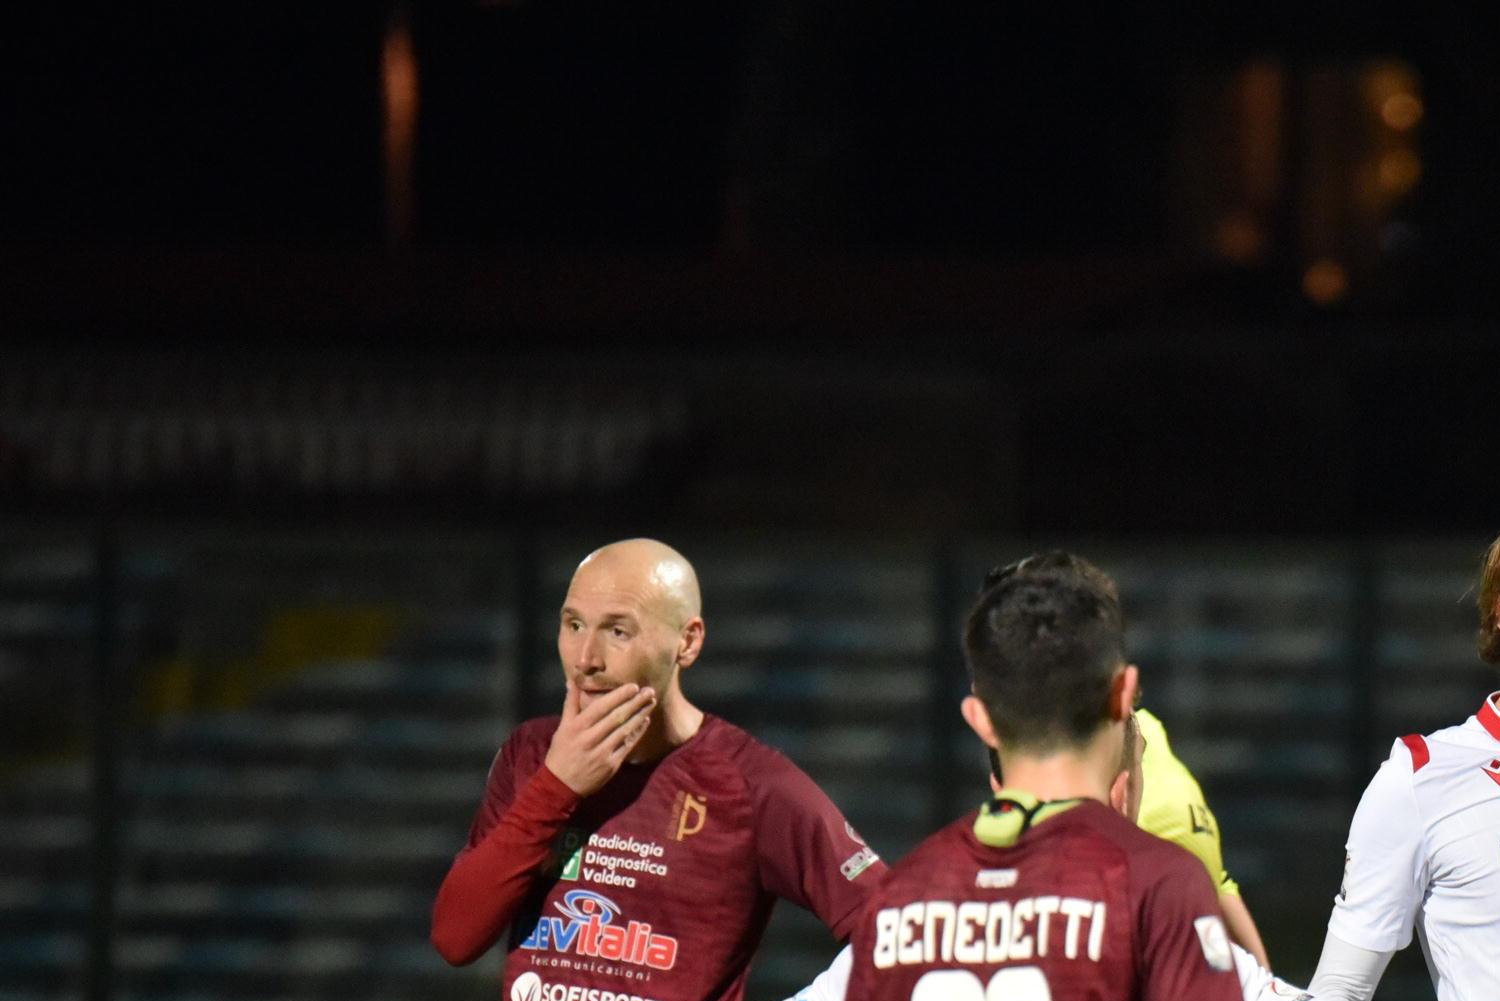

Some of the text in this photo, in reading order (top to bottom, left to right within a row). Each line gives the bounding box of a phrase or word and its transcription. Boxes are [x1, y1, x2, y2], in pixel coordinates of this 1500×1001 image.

[588, 833, 665, 858] Radiologia
[585, 850, 668, 877] Diagnostica
[583, 868, 637, 889] Valdera
[872, 895, 1107, 970] BENEDETTI
[530, 954, 652, 983] Teomunicazioni
